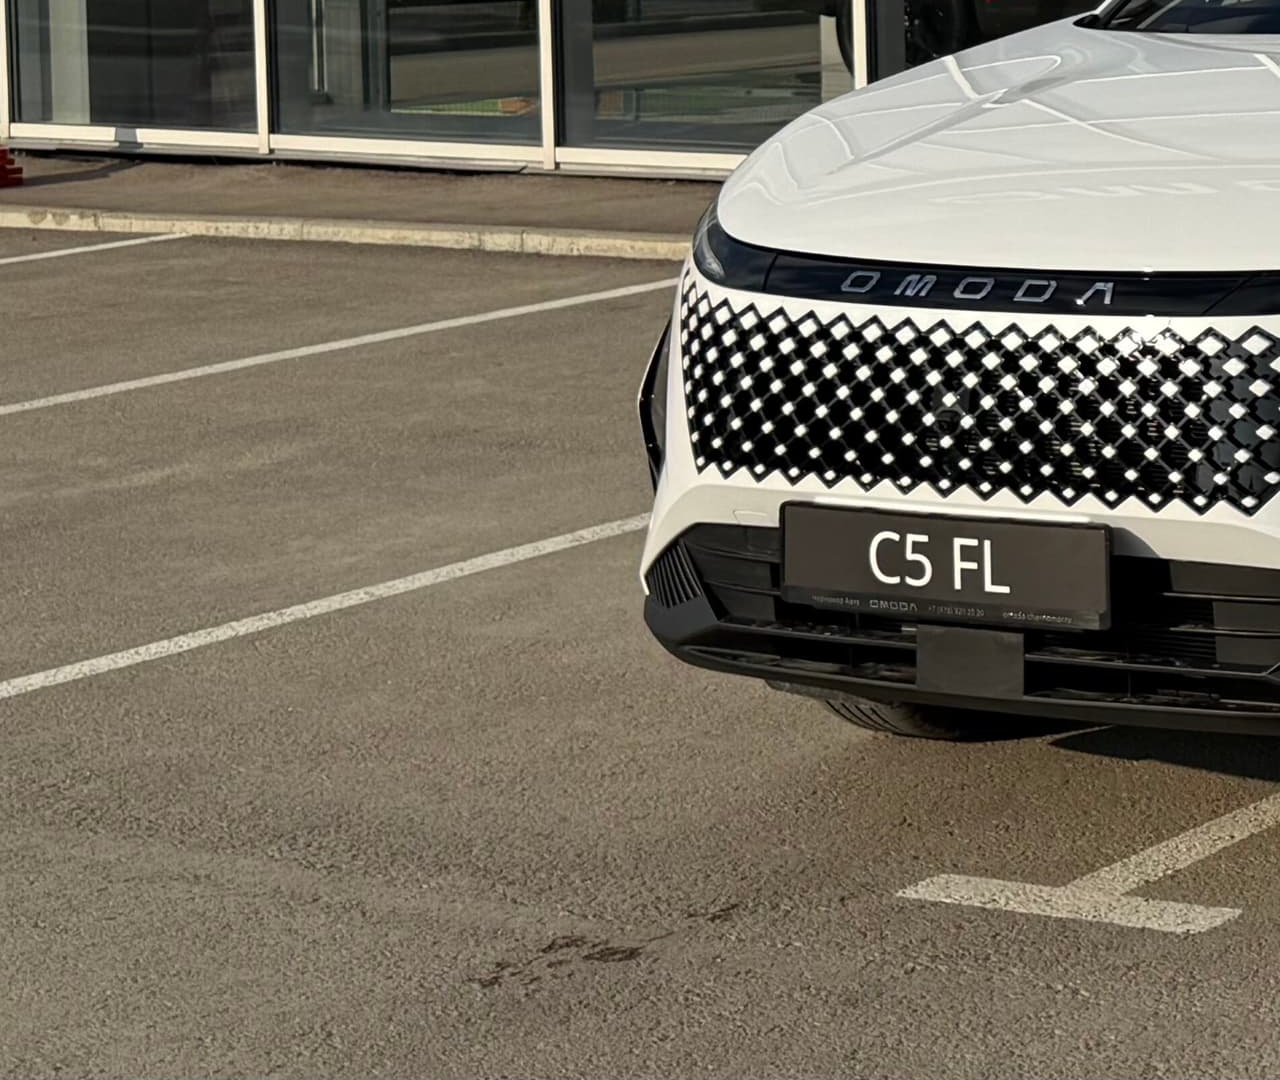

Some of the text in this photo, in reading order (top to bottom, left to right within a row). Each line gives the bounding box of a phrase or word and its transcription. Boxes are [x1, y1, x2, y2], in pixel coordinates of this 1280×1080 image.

[840, 270, 1115, 306] OMODA
[868, 530, 1011, 594] C5 FL
[869, 599, 918, 612] OMODA
